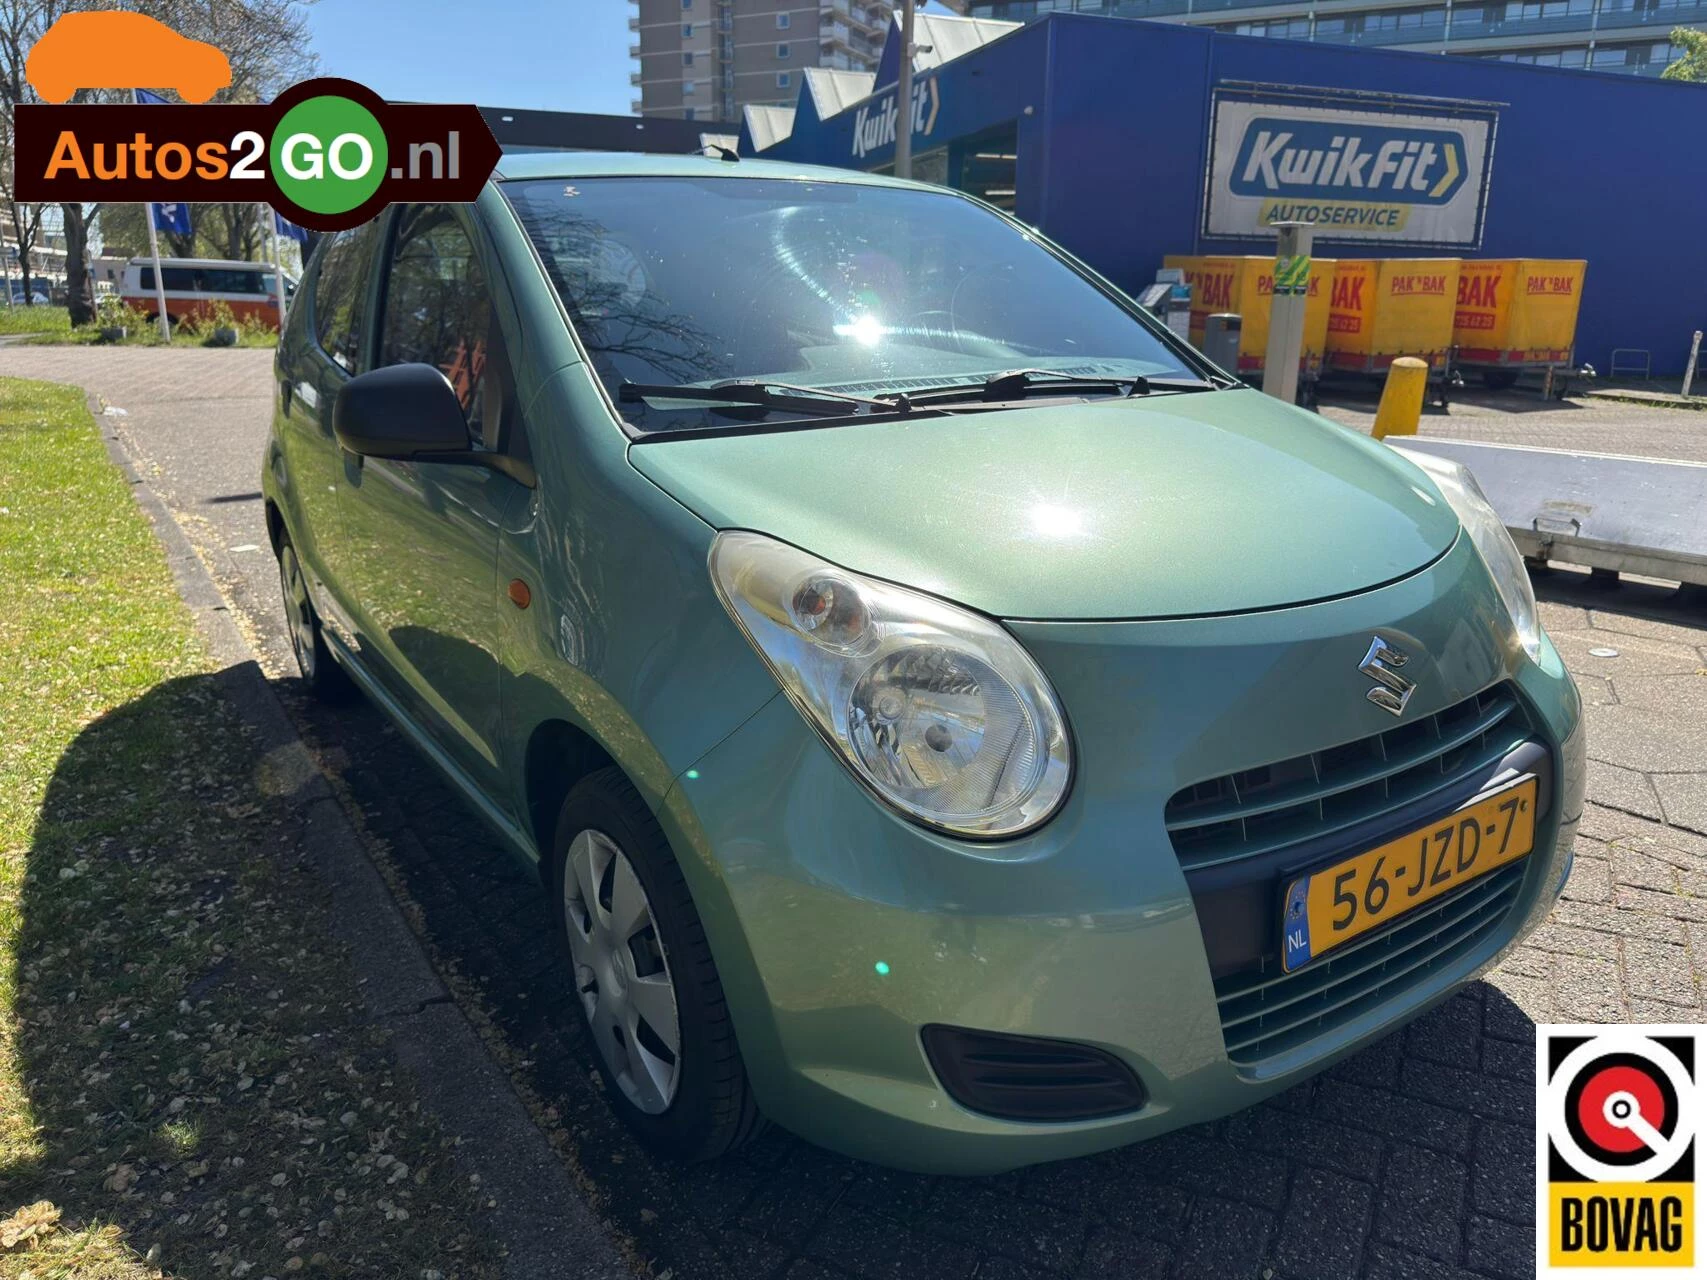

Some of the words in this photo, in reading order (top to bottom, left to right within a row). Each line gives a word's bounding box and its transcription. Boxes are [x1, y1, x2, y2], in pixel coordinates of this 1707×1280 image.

[1265, 204, 1400, 226] AUTOSERVICE
[1202, 272, 1235, 308] BAK
[1456, 275, 1501, 308] BAK
[1332, 797, 1520, 931] 56-JZD-7
[1288, 929, 1307, 953] NL
